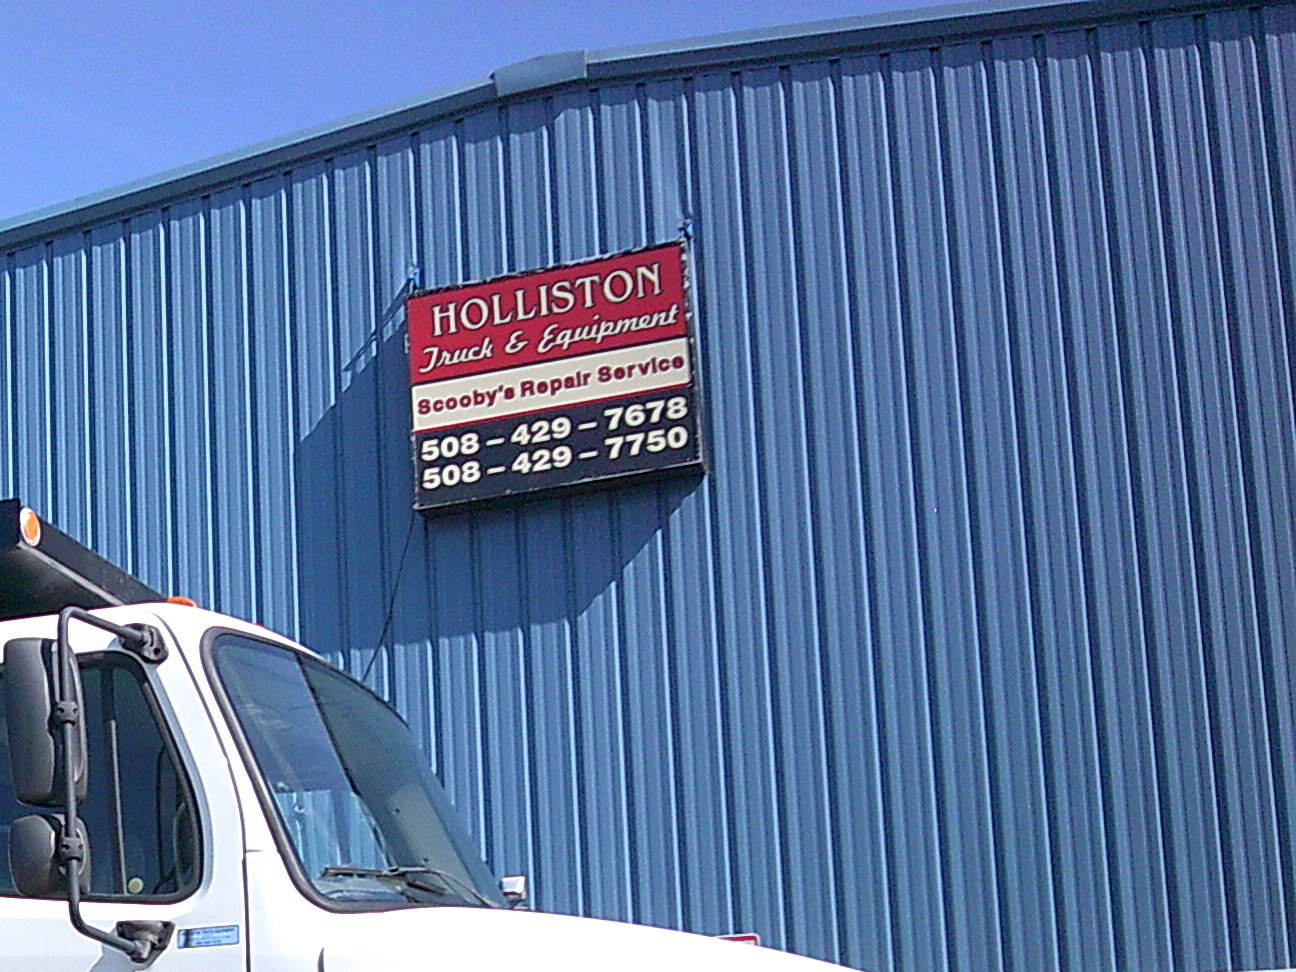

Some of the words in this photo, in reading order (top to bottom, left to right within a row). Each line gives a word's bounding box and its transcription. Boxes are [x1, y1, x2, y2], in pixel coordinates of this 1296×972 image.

[431, 262, 663, 336] HOLLISTON
[418, 336, 494, 373] Truck
[504, 330, 529, 354] &
[536, 303, 679, 354] Equipment
[417, 384, 515, 415] Scooby's
[520, 371, 591, 398] Repair
[597, 356, 684, 382] Service
